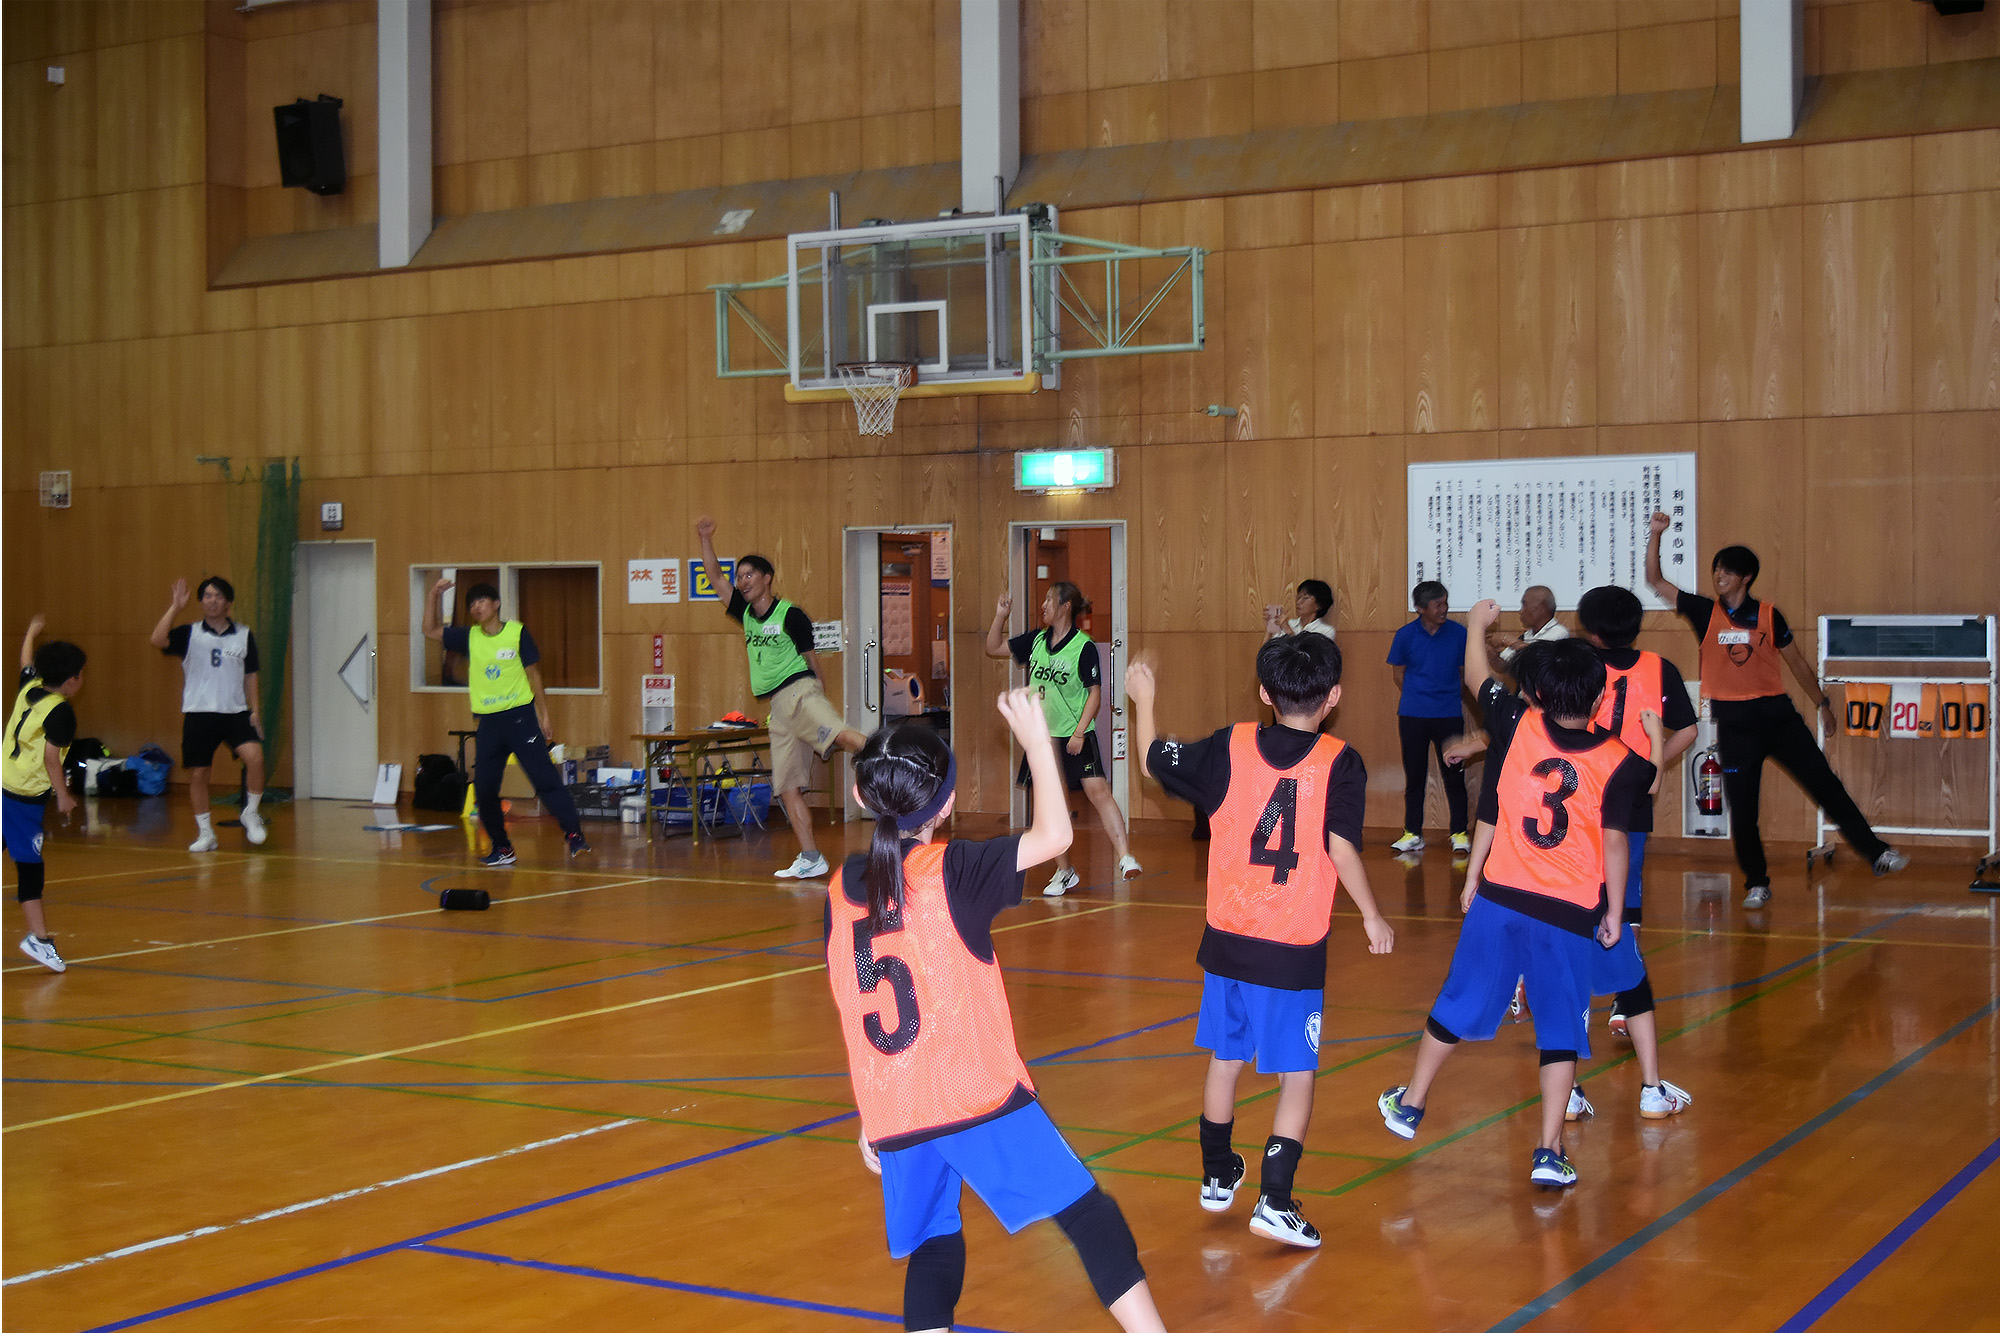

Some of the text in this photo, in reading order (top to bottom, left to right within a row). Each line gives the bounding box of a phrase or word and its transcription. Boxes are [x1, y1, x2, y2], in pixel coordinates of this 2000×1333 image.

[1672, 489, 1684, 565] 利用者心得
[211, 648, 222, 667] 6
[752, 634, 779, 647] asics
[1759, 631, 1767, 647] 7
[1034, 665, 1070, 685] asics
[9, 707, 33, 761] 1
[1893, 702, 1919, 731] 20
[1521, 757, 1579, 850] 3
[1250, 777, 1299, 886] 4
[852, 903, 921, 1056] 5
